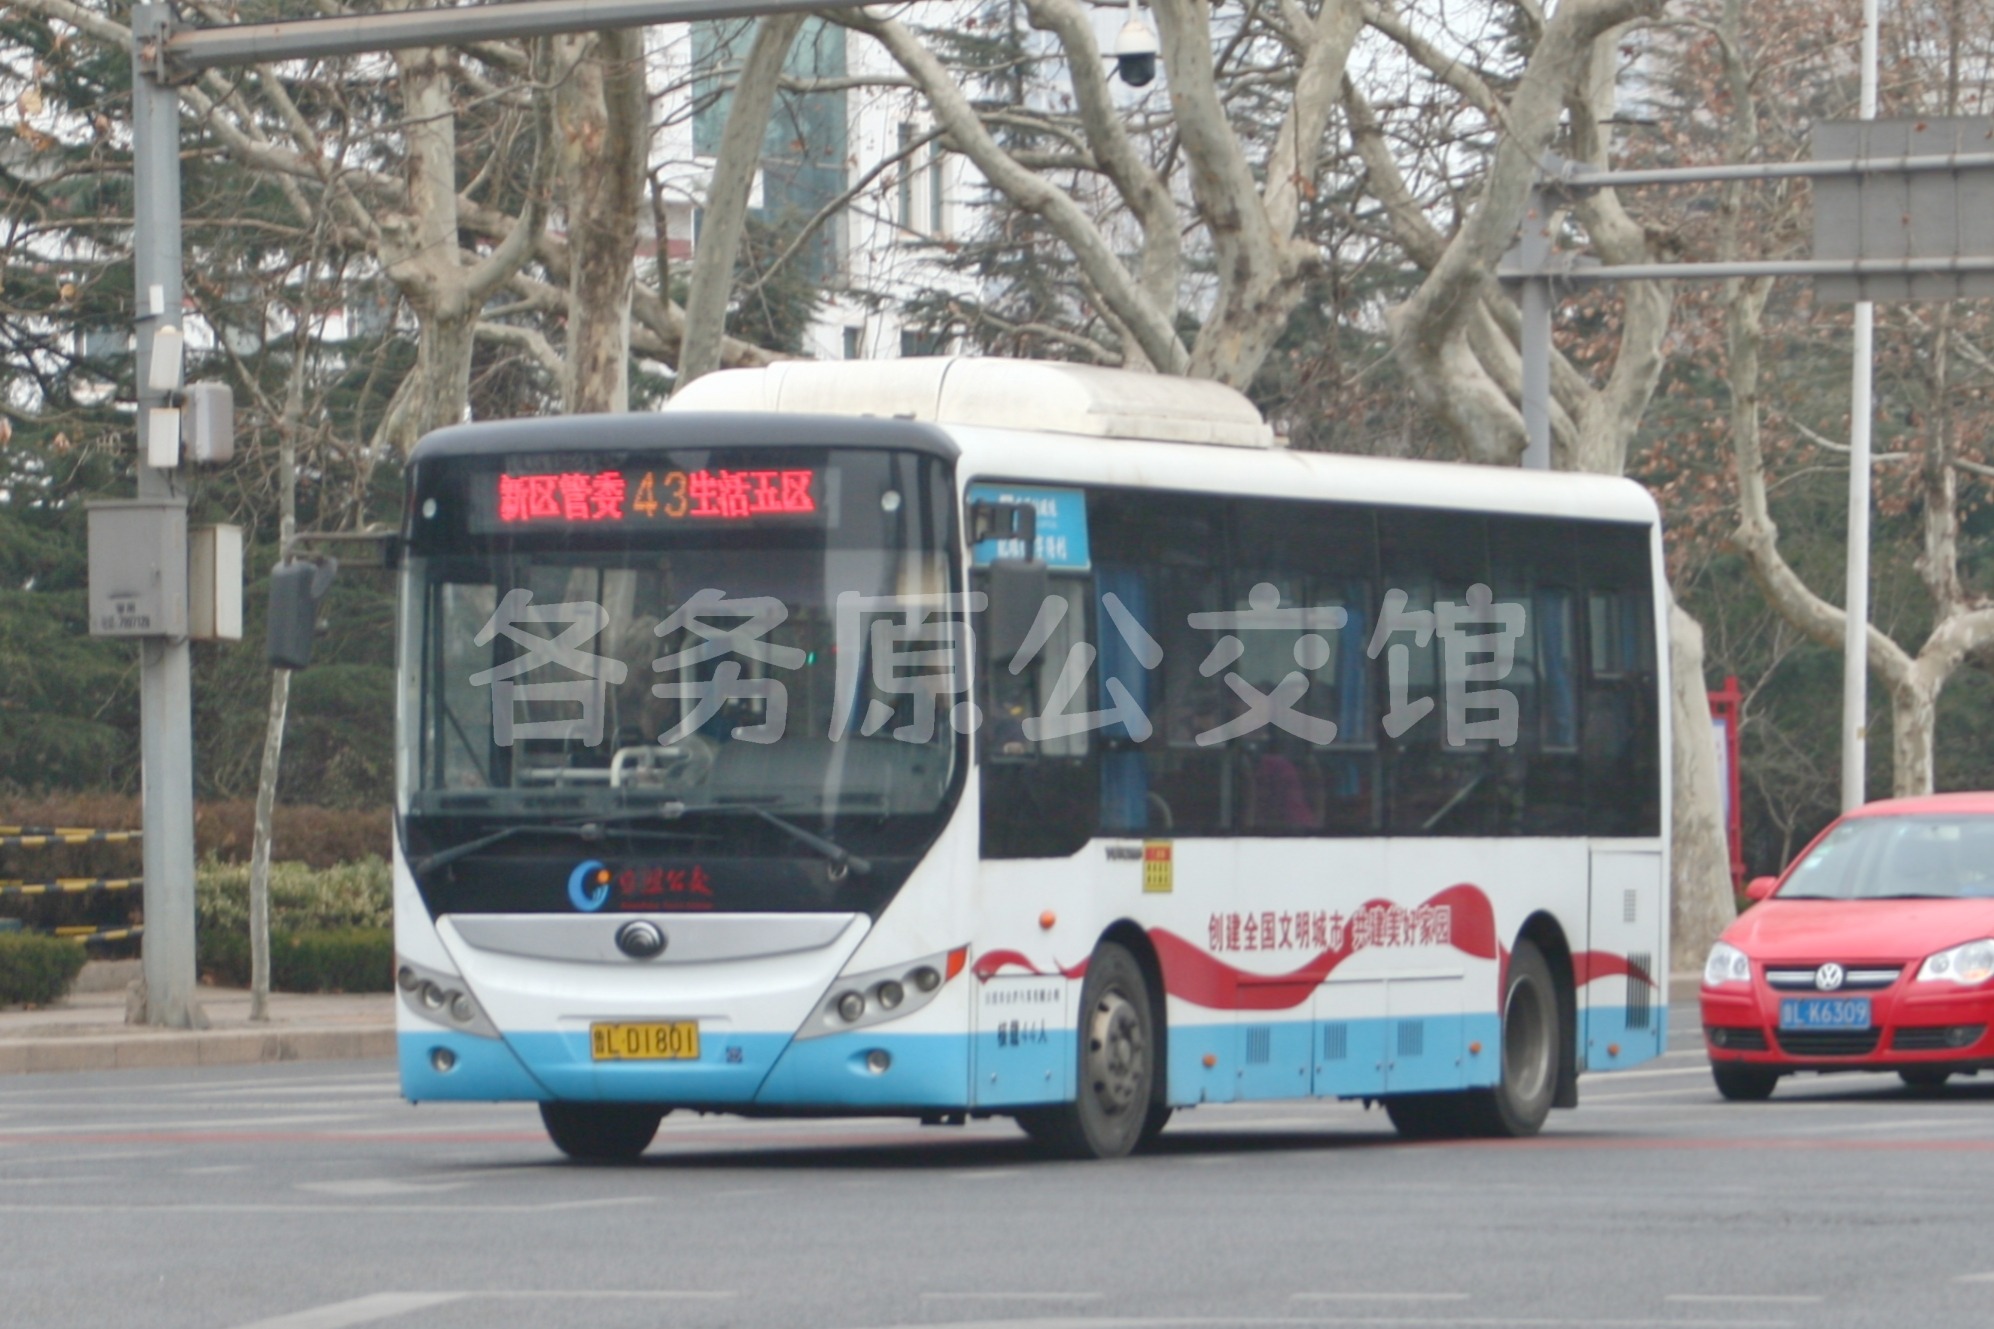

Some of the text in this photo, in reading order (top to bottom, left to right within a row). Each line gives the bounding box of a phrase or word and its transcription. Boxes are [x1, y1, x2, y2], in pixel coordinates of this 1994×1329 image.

[500, 469, 814, 520] 新区管委 43 生活五区
[1208, 905, 1451, 953] 创建全国文明城市 共建美好家园
